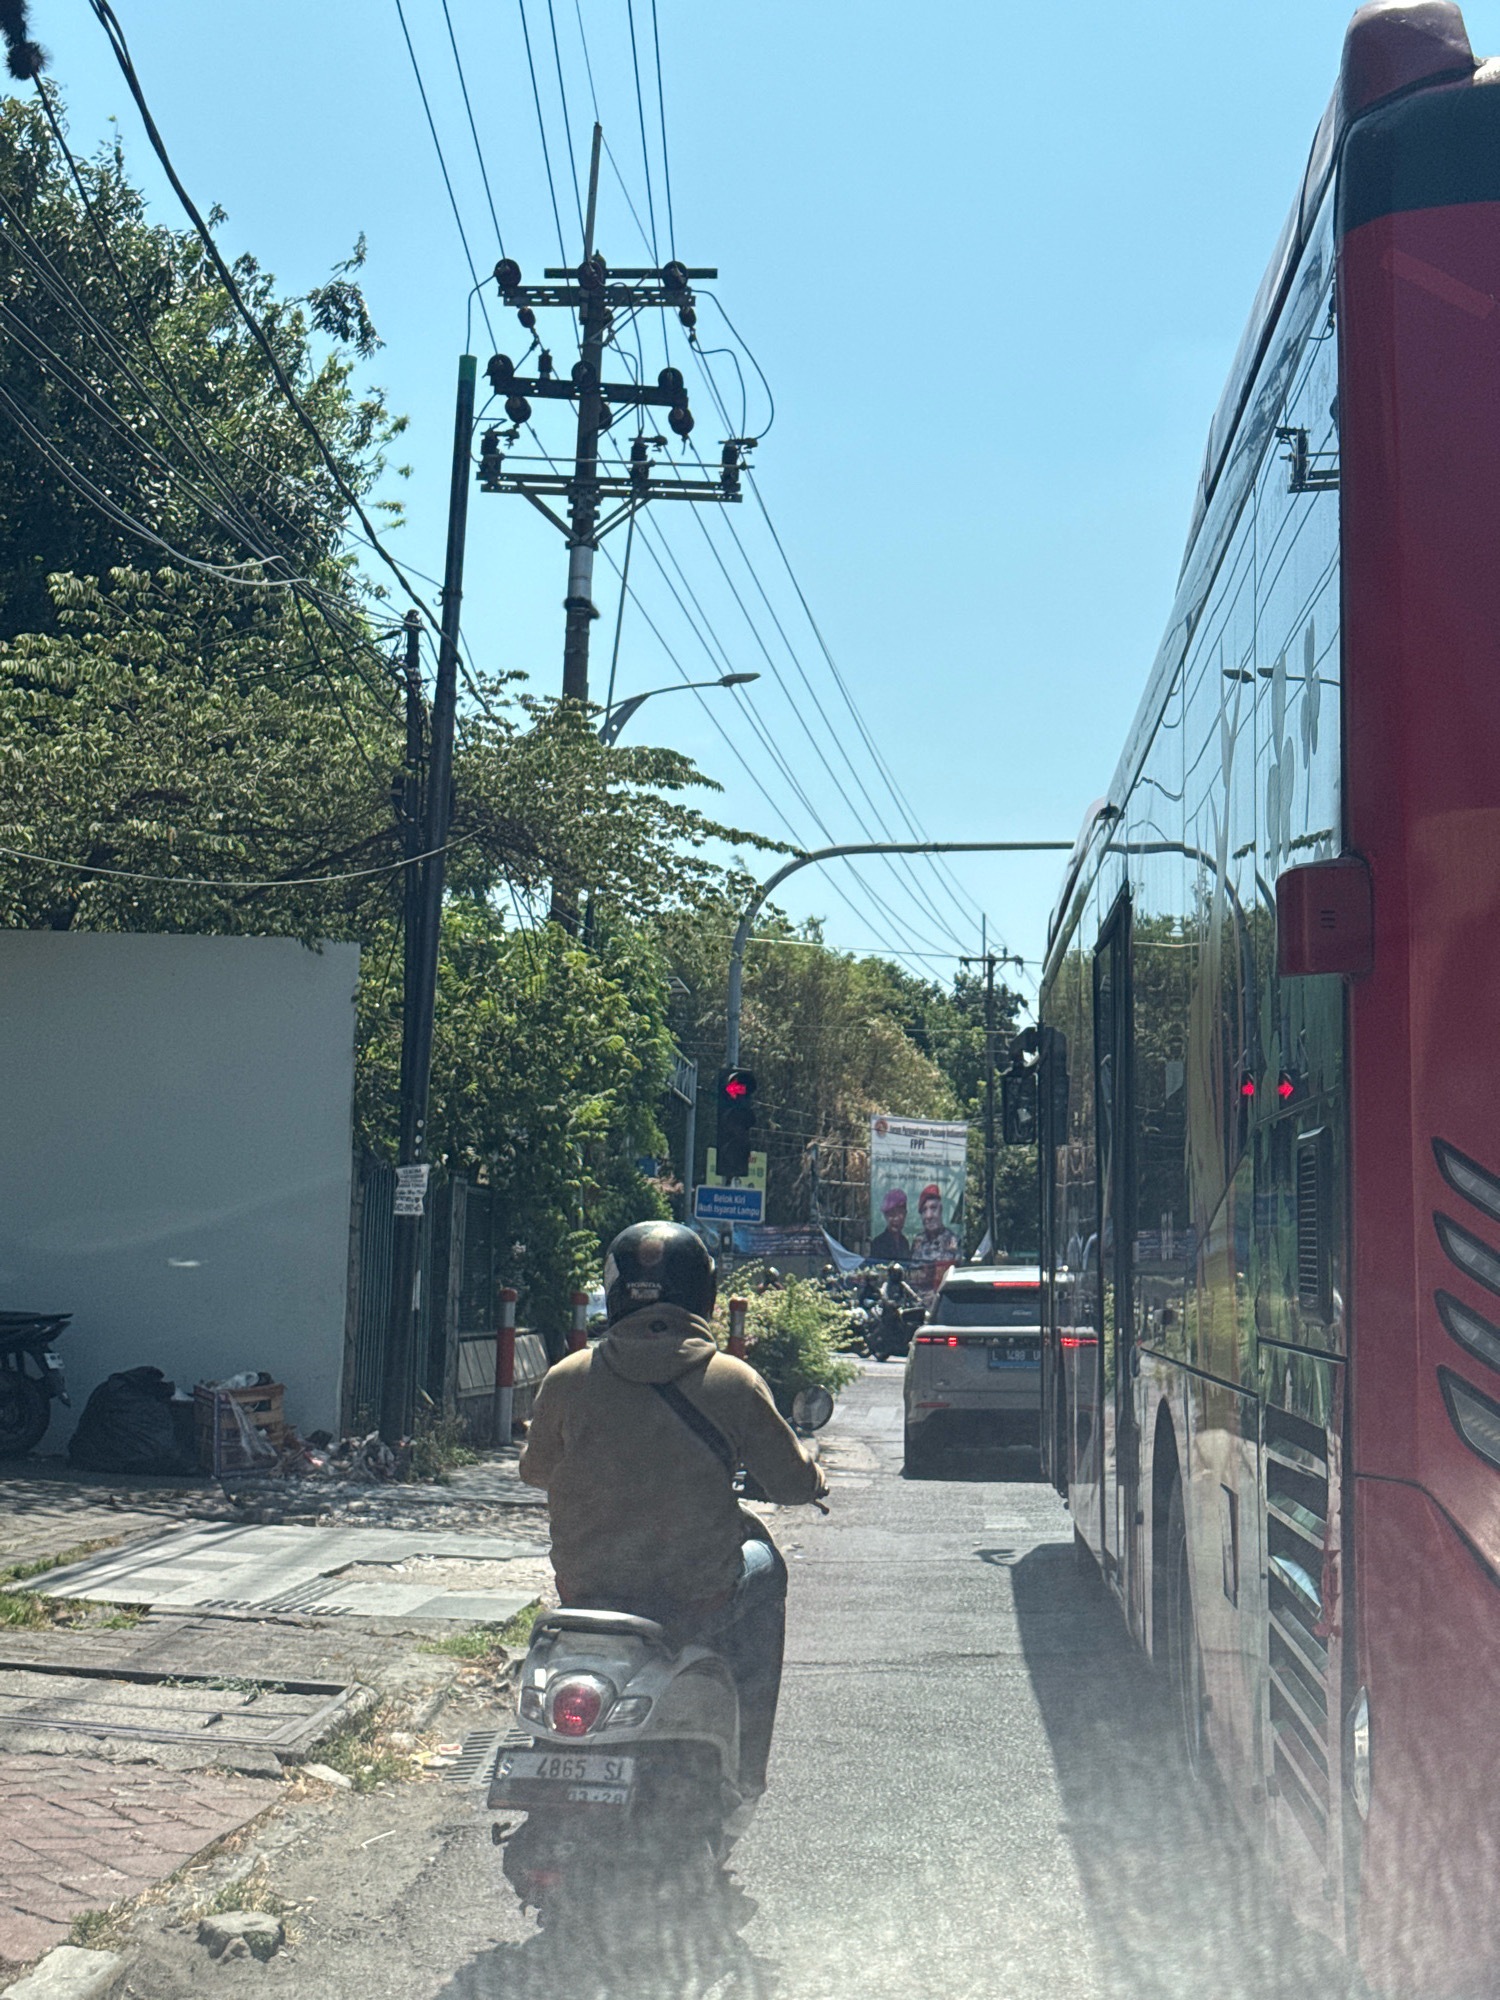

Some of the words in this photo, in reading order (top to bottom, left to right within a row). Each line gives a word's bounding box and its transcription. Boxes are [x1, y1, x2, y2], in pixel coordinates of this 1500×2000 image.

[714, 1193, 732, 1203] Belok
[734, 1195, 746, 1204] Kiri
[738, 1206, 760, 1217] Lampu
[536, 1757, 587, 1780] 4865
